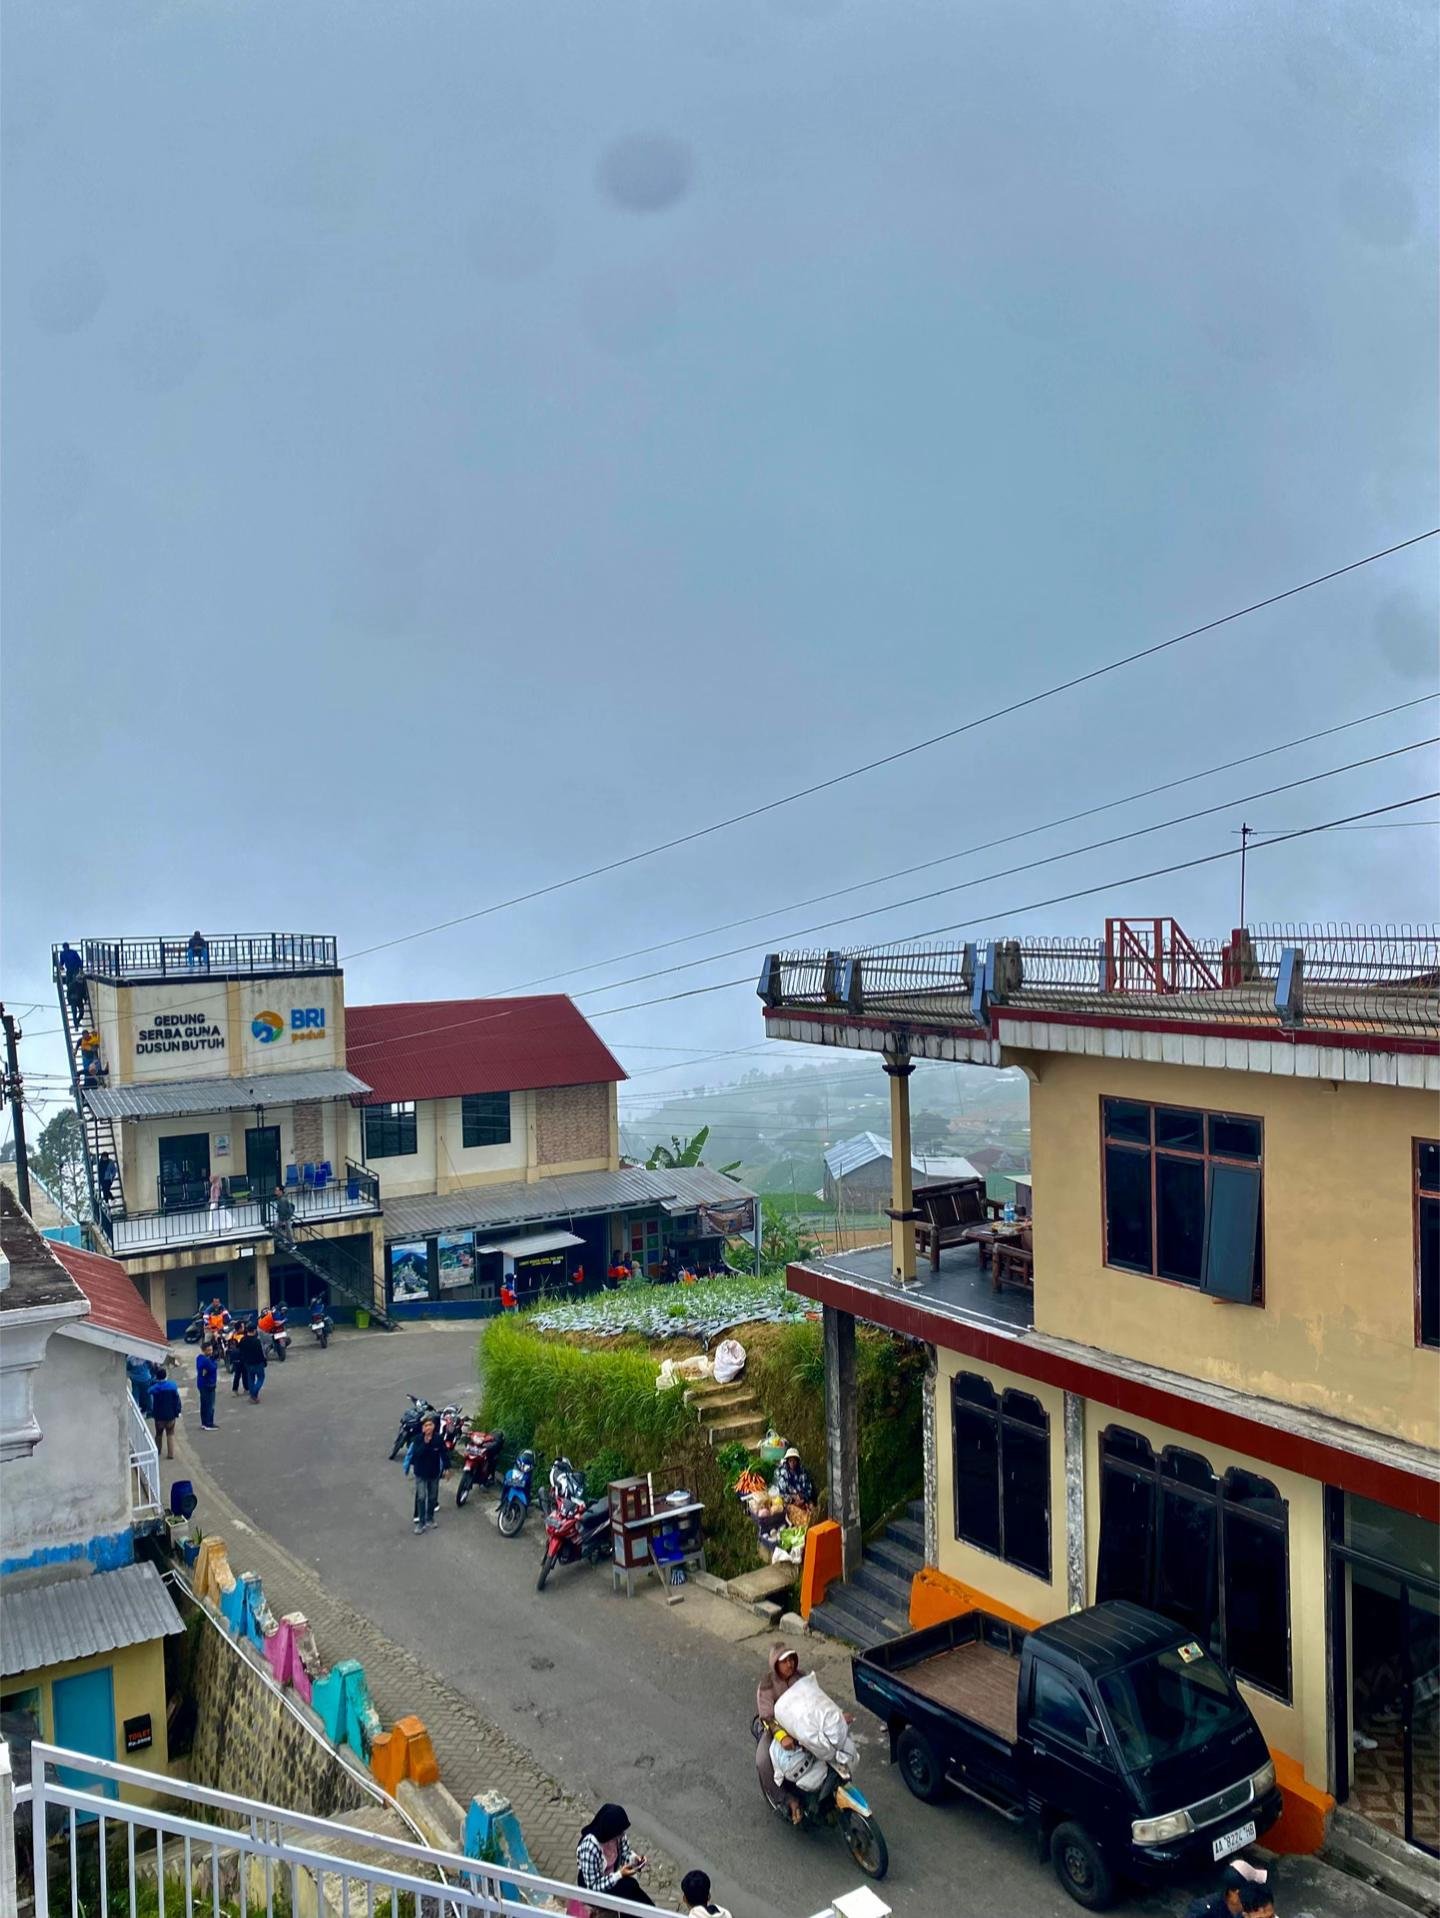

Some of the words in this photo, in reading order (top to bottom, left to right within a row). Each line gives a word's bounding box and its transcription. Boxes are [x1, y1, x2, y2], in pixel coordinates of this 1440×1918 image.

[154, 1013, 206, 1027] GEDUNG
[291, 1007, 325, 1029] BRI
[139, 1028, 182, 1041] SERBA
[184, 1025, 220, 1038] GUNA
[136, 1041, 180, 1055] DUSUN
[181, 1038, 225, 1052] BUTUH
[128, 1729, 151, 1742] TOILET
[1215, 1840, 1224, 1854] AA
